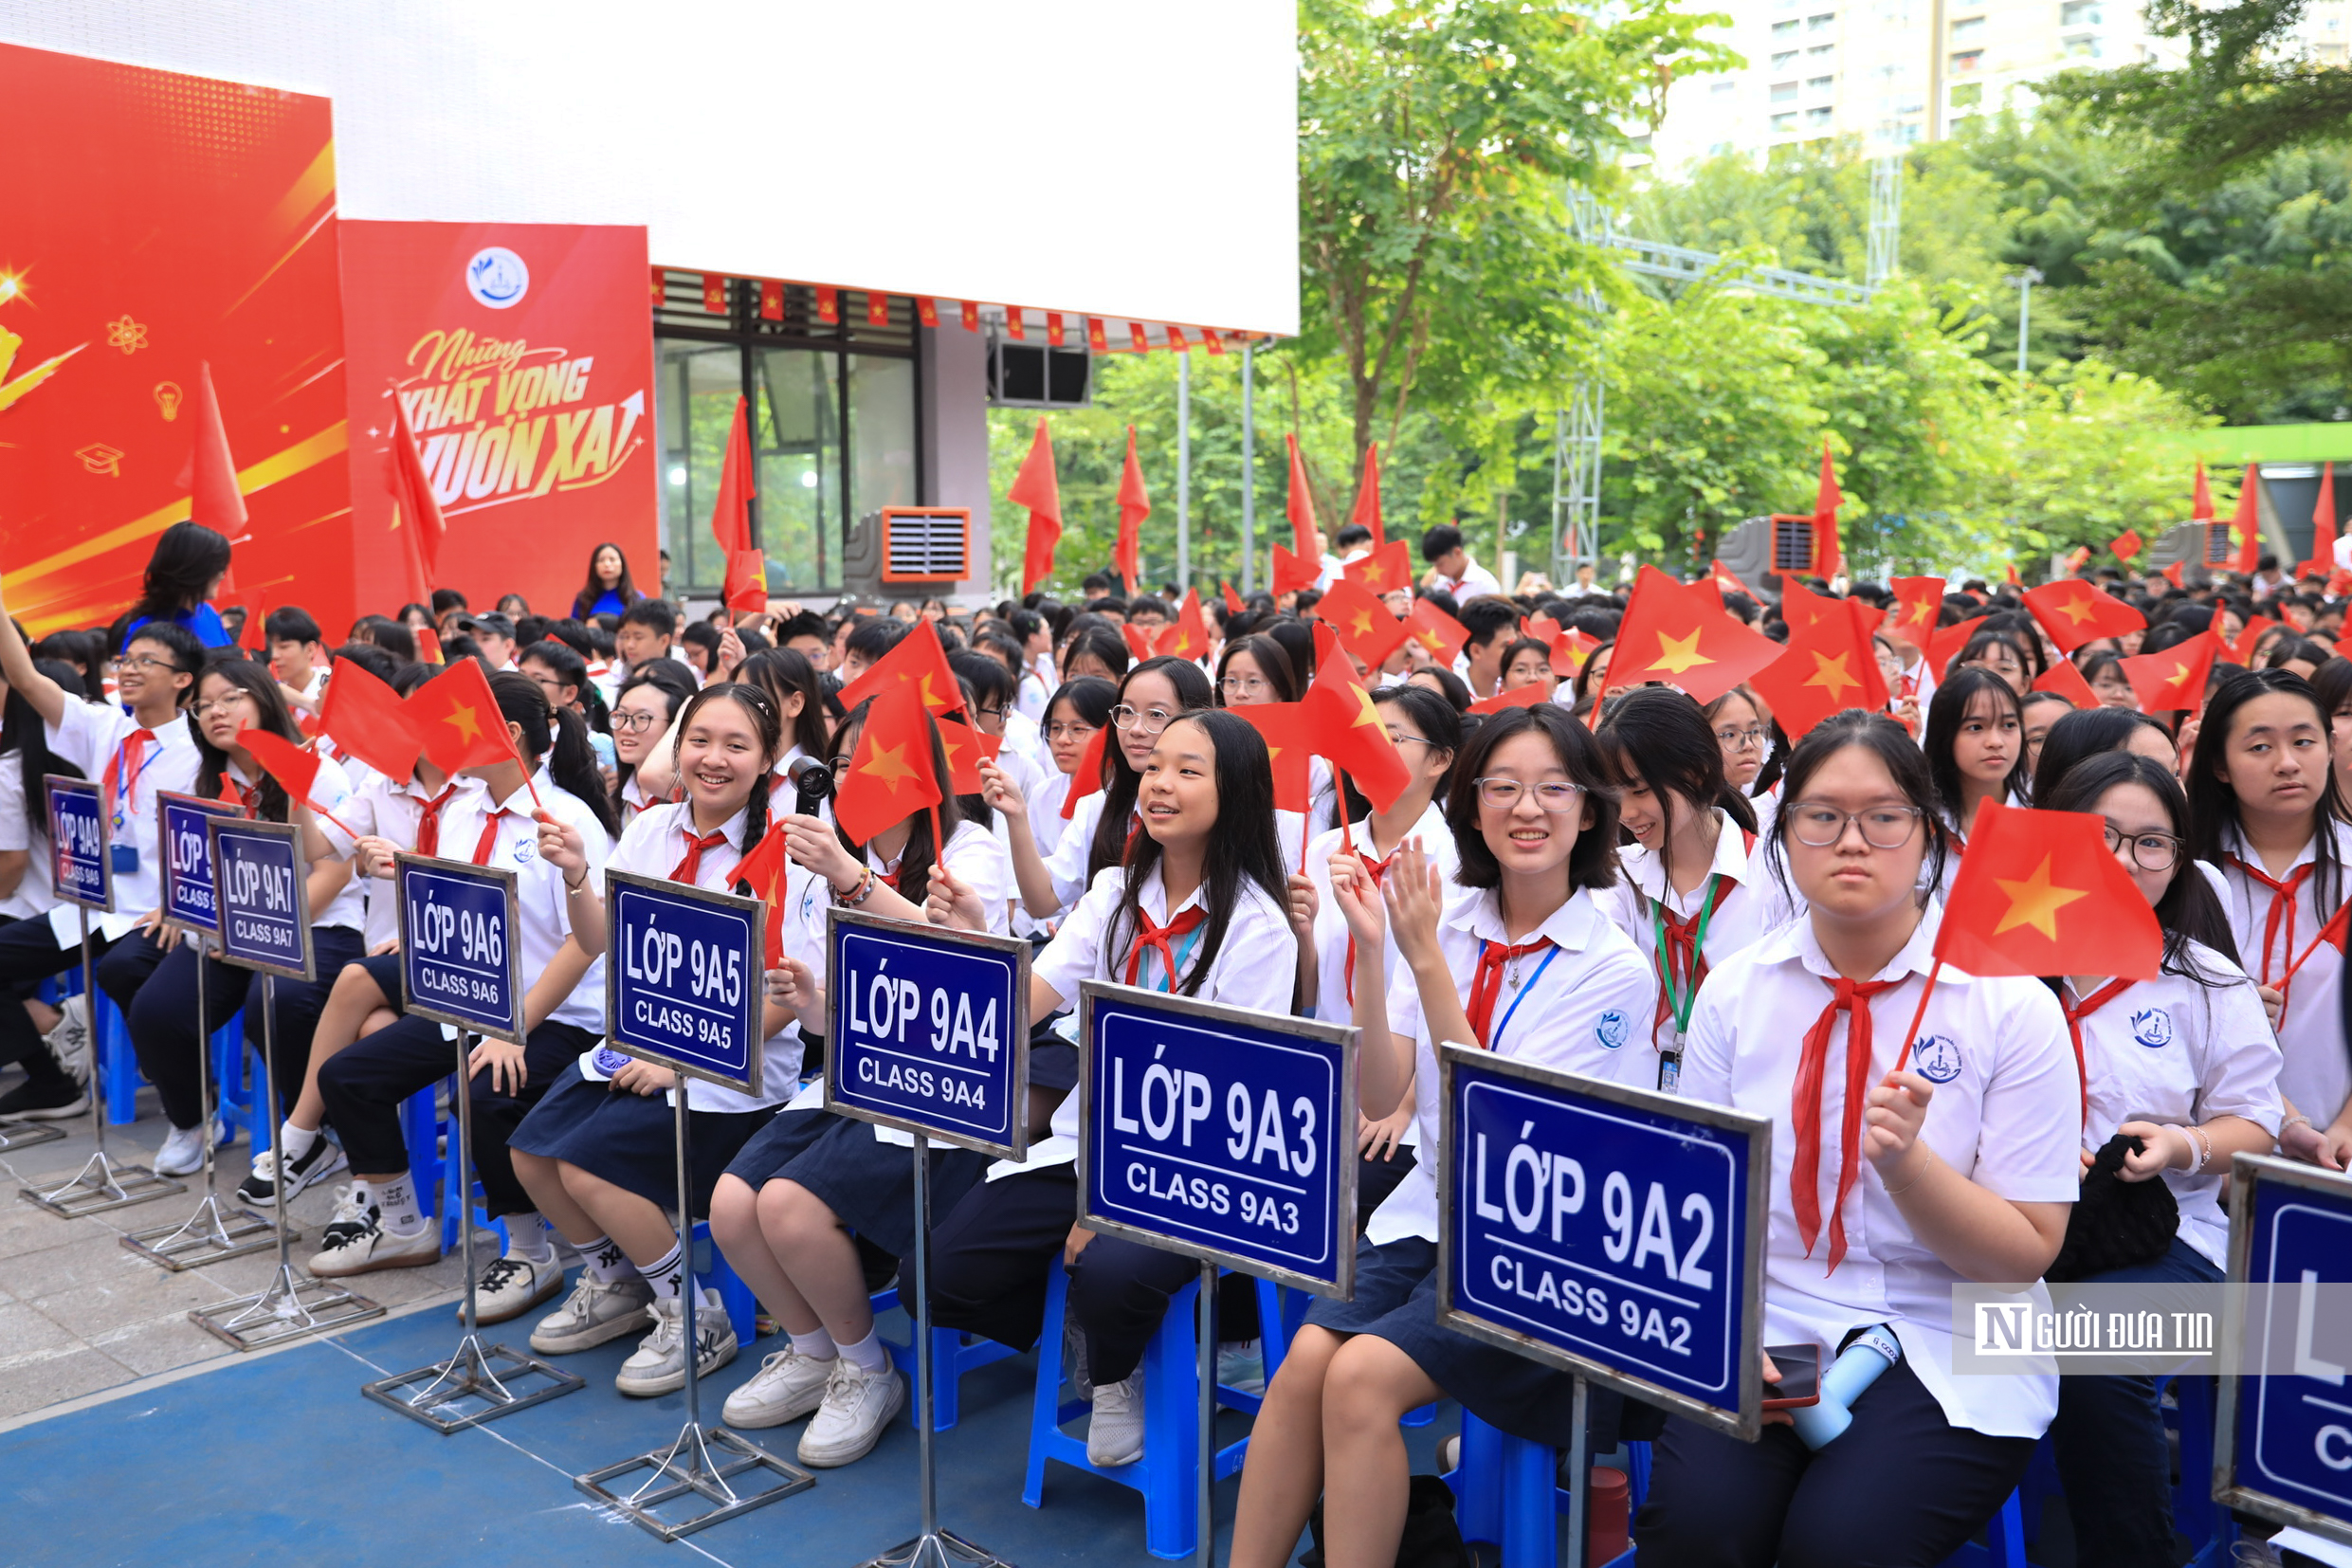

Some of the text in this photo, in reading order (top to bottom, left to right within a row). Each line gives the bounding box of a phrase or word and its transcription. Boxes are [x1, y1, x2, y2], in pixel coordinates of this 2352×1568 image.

[406, 328, 567, 381] Những
[495, 356, 593, 419] VỌNG
[55, 801, 100, 857] LỚP 9A9
[171, 820, 202, 874] LỚP
[61, 862, 100, 886] CLASS 9A9
[176, 884, 210, 909] CLASS
[225, 848, 260, 906] LỚP
[263, 864, 292, 913] 9A7
[235, 920, 293, 947] CLASS 9A7
[411, 889, 502, 967] LỚP 9A6
[422, 967, 499, 1005] CLASS 9A6
[627, 913, 741, 1007] LỚP 9A5
[635, 999, 732, 1049] CLASS 9A5
[850, 957, 999, 1063] LỚP 9A4
[858, 1057, 986, 1110] CLASS 9A4
[1114, 1044, 1317, 1177] LỚP 9A3
[1125, 1162, 1301, 1234] CLASS 9A3
[1475, 1121, 1715, 1290] LỚP 9A2
[1490, 1254, 1692, 1357] CLASS 9A2
